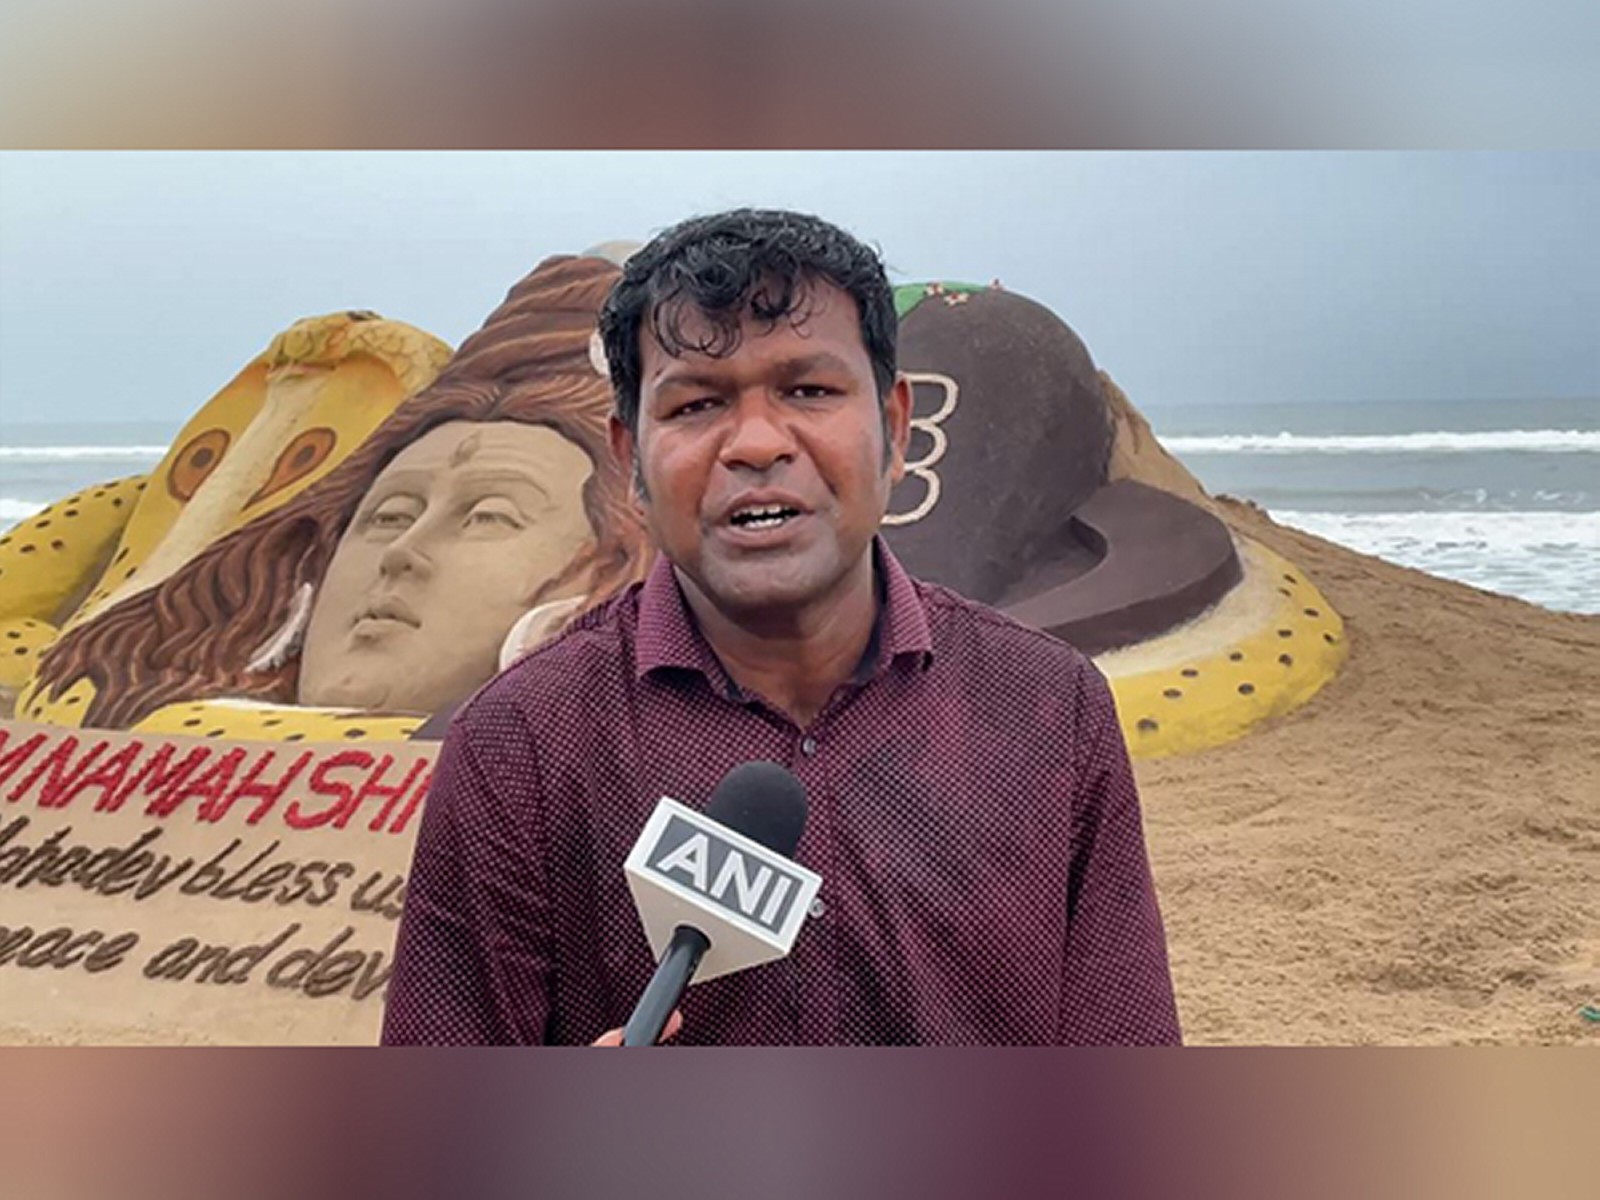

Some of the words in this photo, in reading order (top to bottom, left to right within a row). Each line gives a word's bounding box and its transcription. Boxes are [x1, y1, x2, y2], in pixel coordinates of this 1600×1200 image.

[0, 815, 194, 901] ahadev
[180, 838, 355, 907] bless
[656, 832, 792, 926] ANI
[143, 922, 302, 985] and
